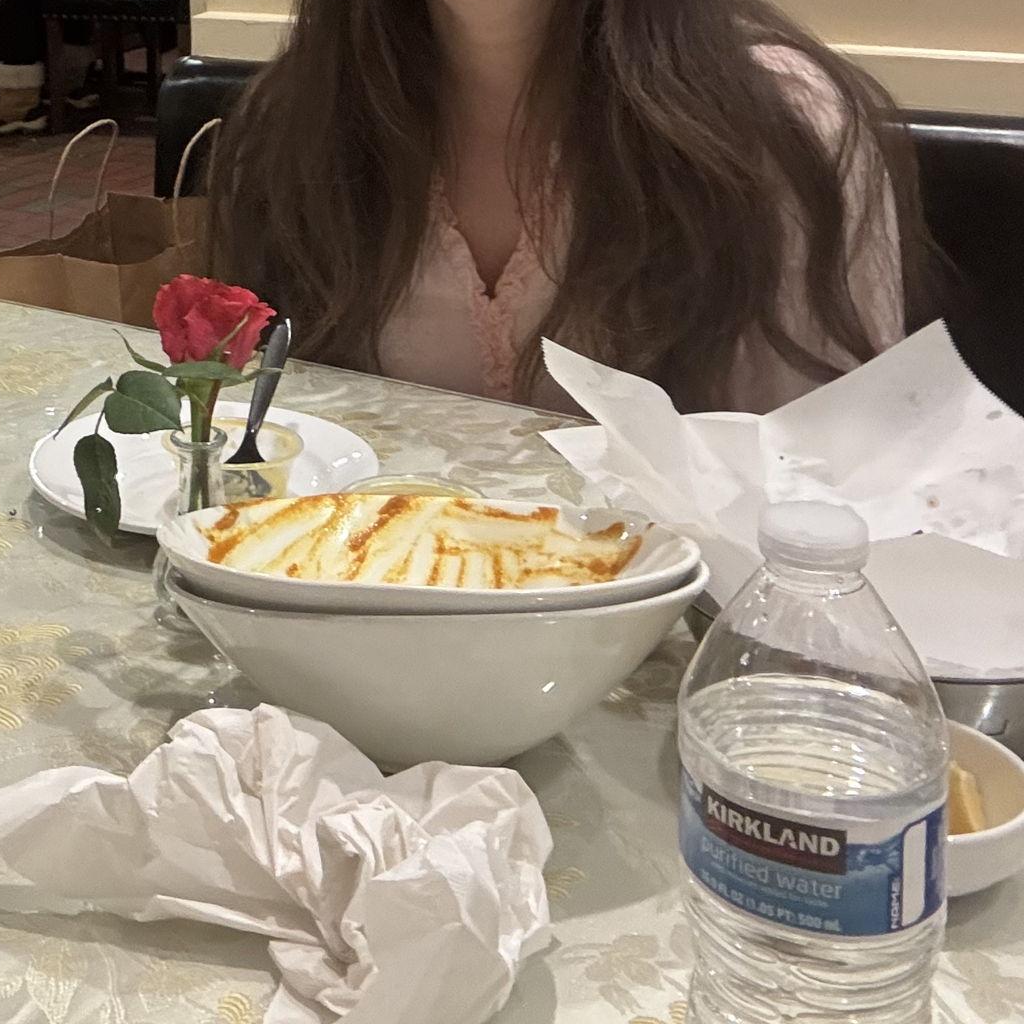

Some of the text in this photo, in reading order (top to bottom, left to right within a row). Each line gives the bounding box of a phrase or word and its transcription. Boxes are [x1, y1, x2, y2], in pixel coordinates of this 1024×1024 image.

[707, 795, 841, 857] KIRKLAND
[702, 836, 769, 884] purified
[777, 871, 843, 900] water
